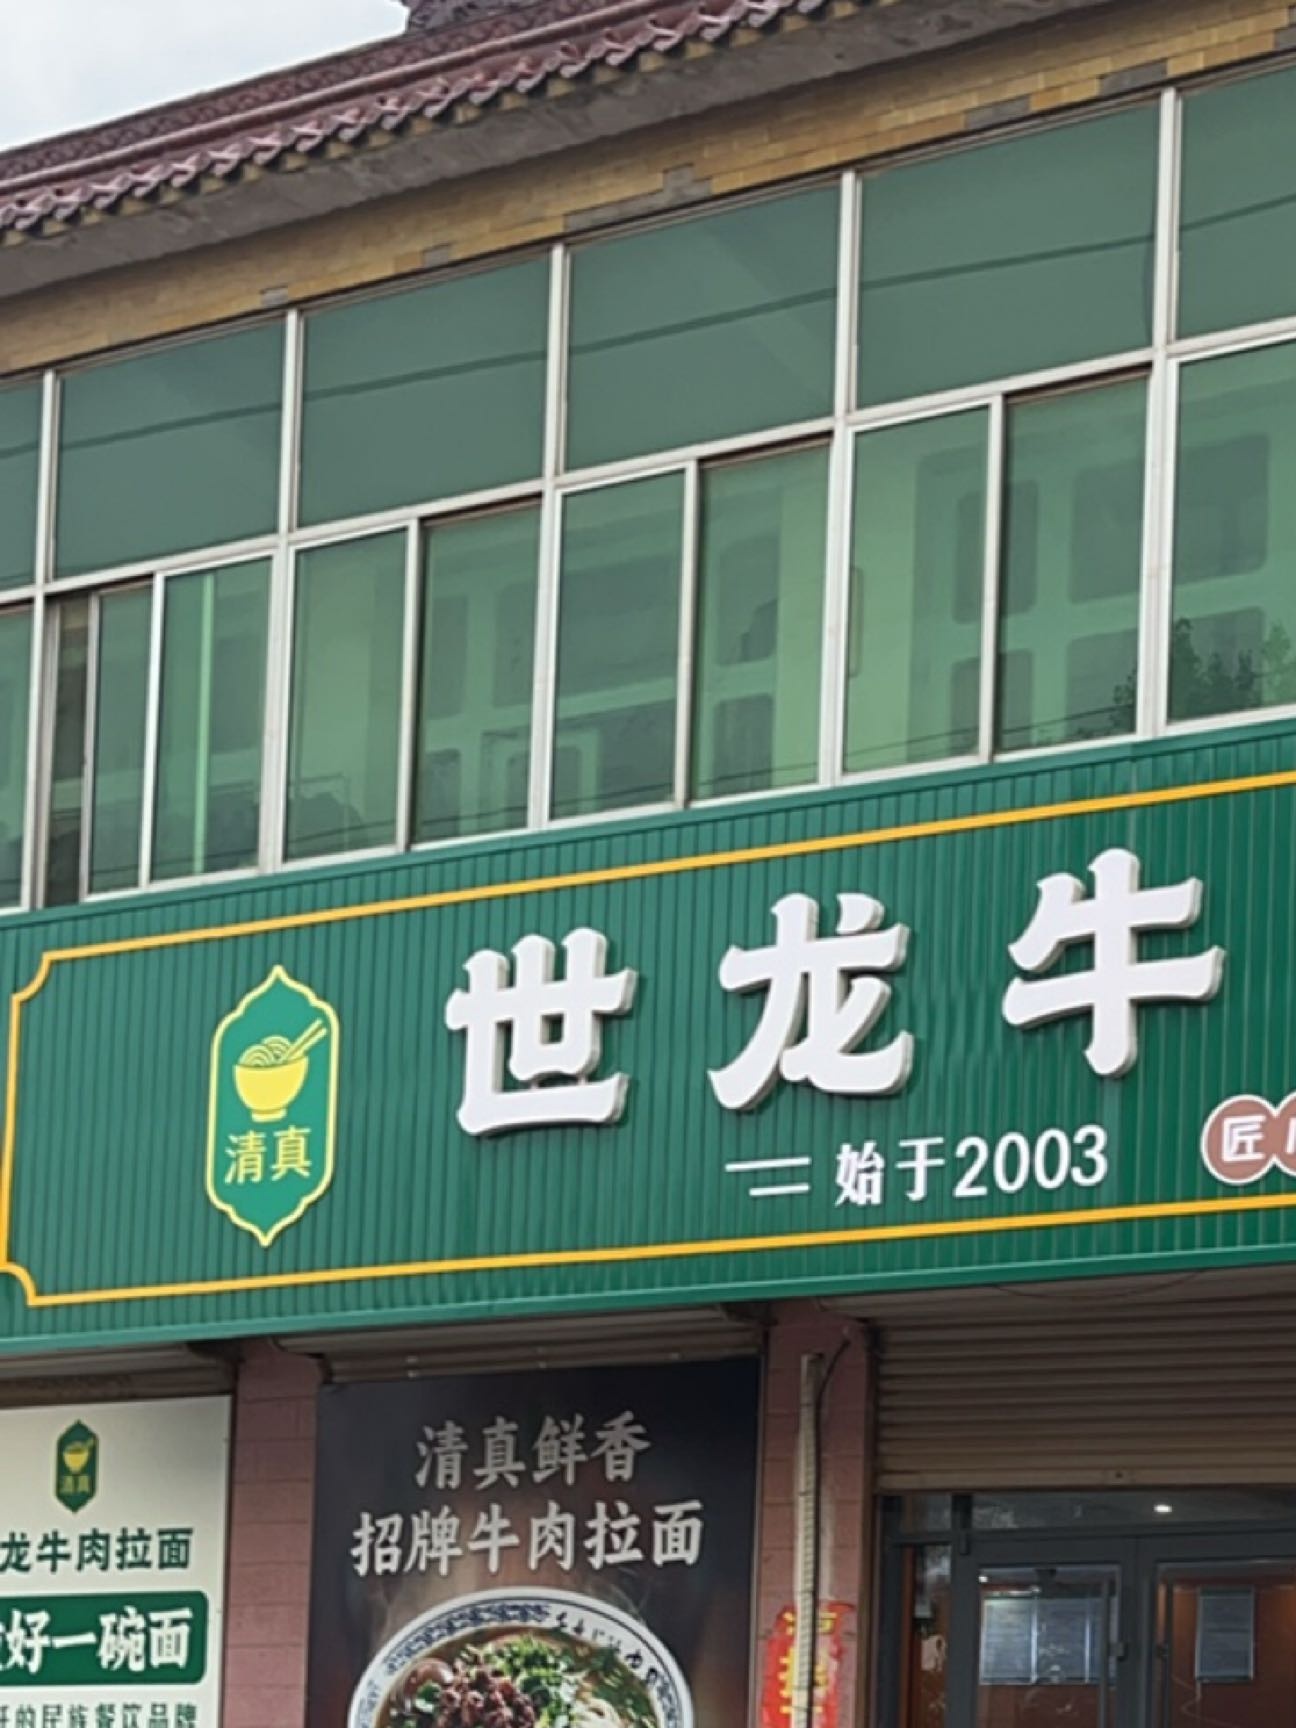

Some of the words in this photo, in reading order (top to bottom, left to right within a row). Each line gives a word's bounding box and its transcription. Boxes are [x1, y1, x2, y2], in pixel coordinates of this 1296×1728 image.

[224, 1126, 312, 1184] 清真
[834, 1124, 1108, 1207] 始于2003
[415, 1410, 651, 1489] 清真鲜香
[0, 1527, 193, 1573] 龙牛肉拉面
[351, 1499, 704, 1577] 招牌牛肉拉面
[0, 1606, 193, 1674] 好一碗面
